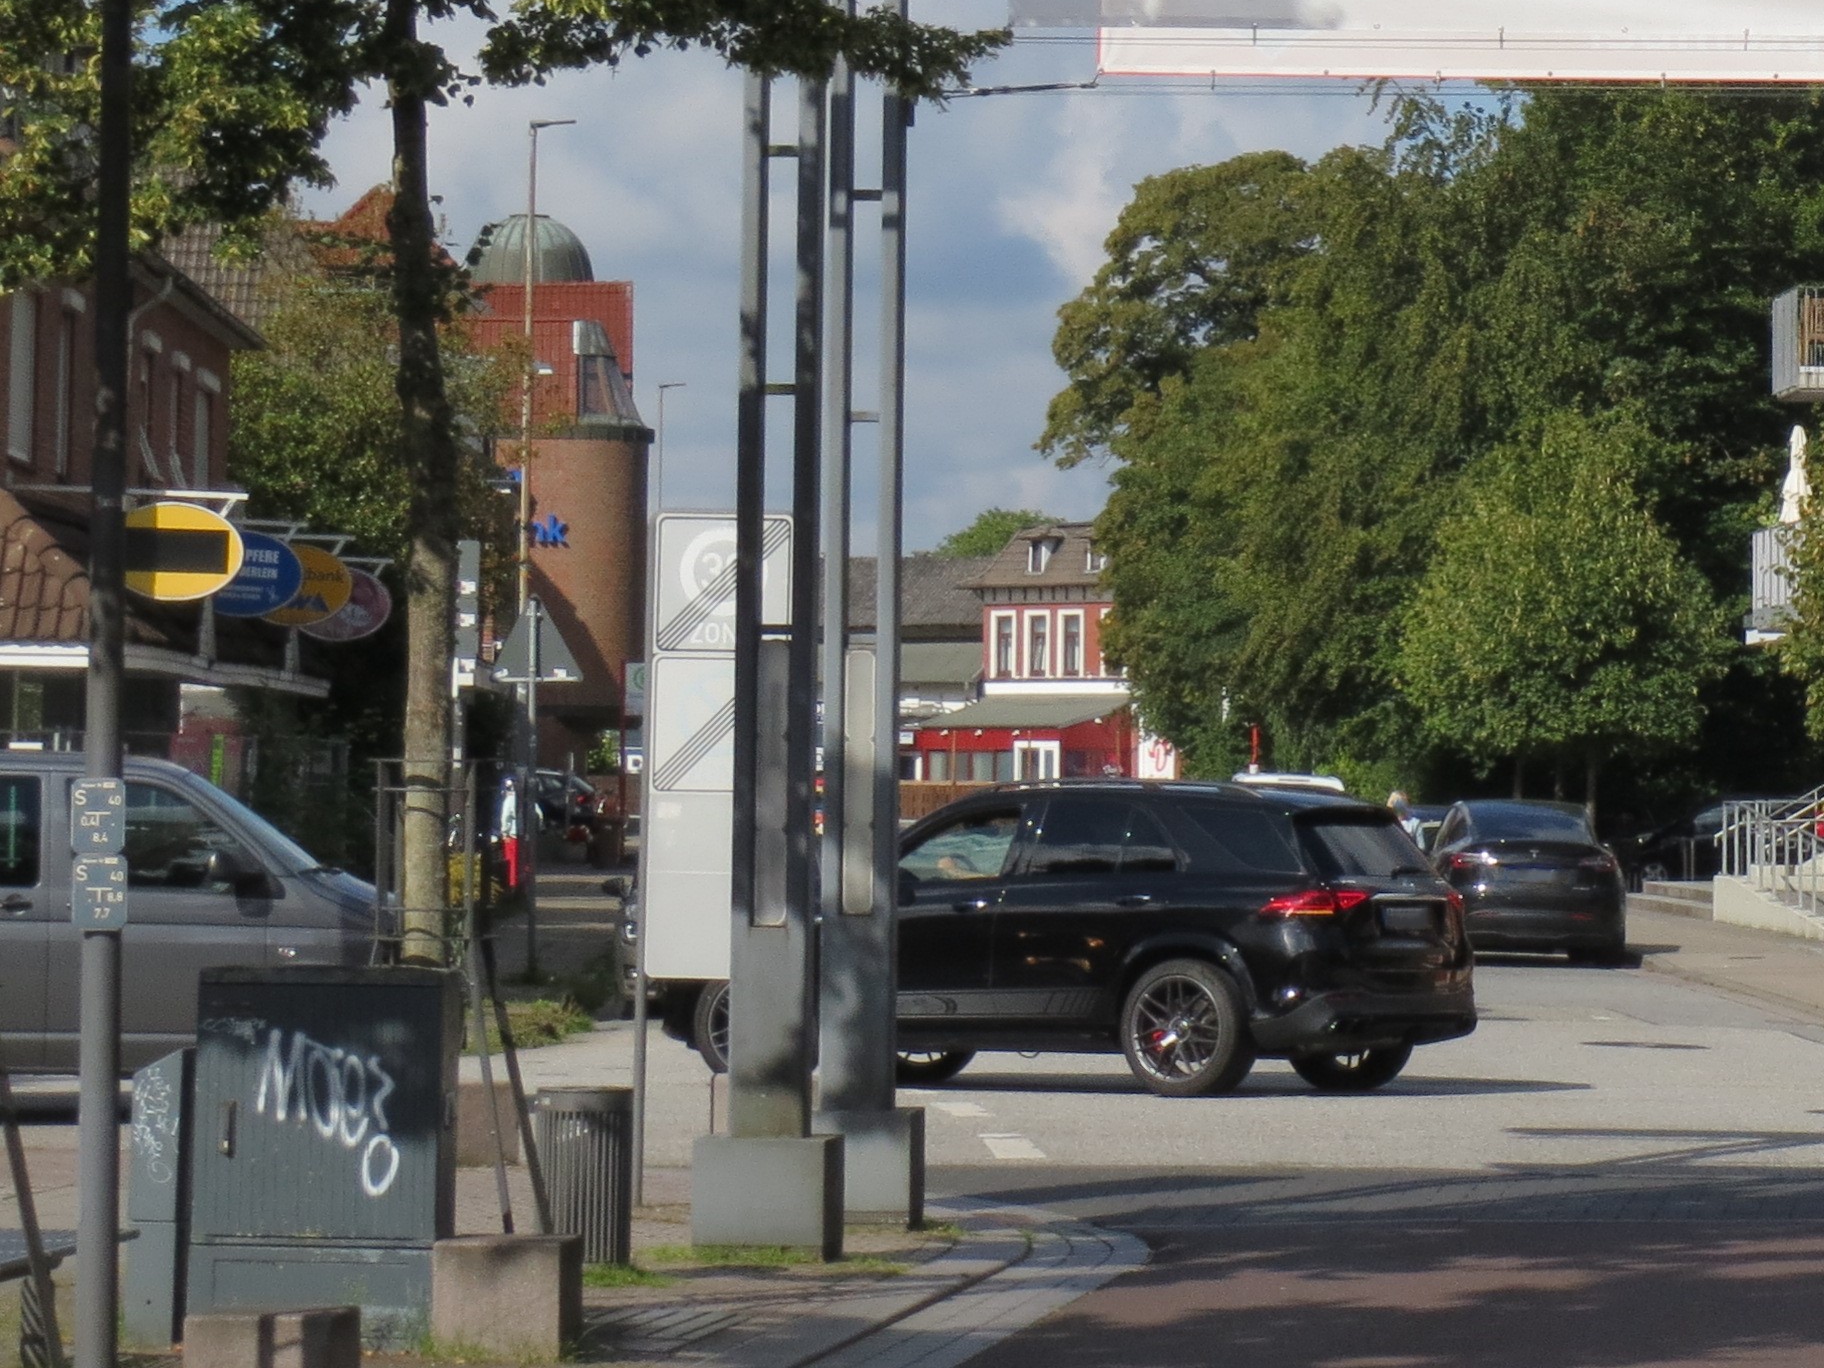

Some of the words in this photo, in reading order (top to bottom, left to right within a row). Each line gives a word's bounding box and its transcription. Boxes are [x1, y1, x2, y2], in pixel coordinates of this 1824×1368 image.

[246, 548, 280, 564] PFERE
[690, 622, 736, 644] ZON
[74, 789, 87, 806] S
[76, 865, 88, 881] S
